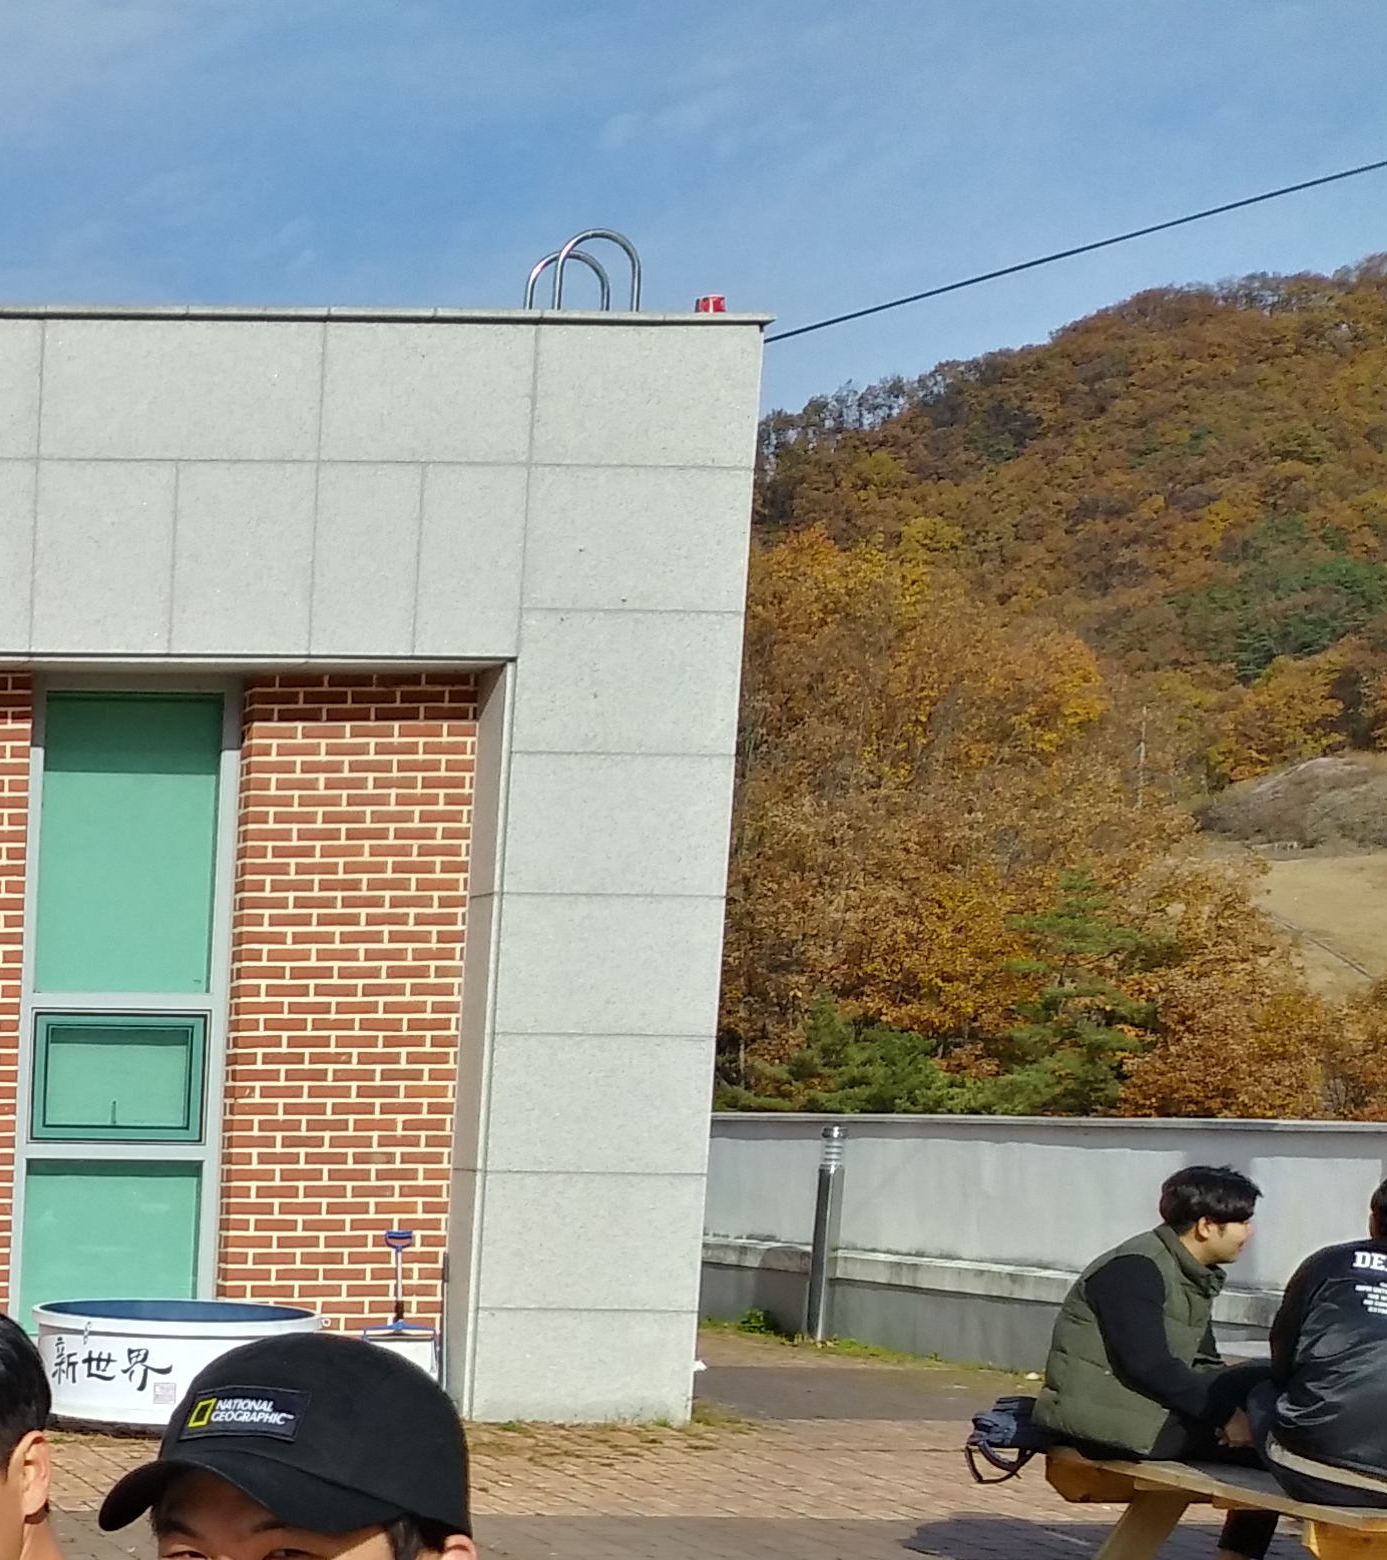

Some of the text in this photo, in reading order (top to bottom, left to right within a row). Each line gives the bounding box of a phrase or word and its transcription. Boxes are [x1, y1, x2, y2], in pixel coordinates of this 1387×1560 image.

[1352, 1251, 1387, 1272] DE
[51, 1336, 173, 1392] 新世界
[215, 1398, 274, 1413] NATIONAL
[210, 1411, 287, 1425] GEOGRAPHIC
